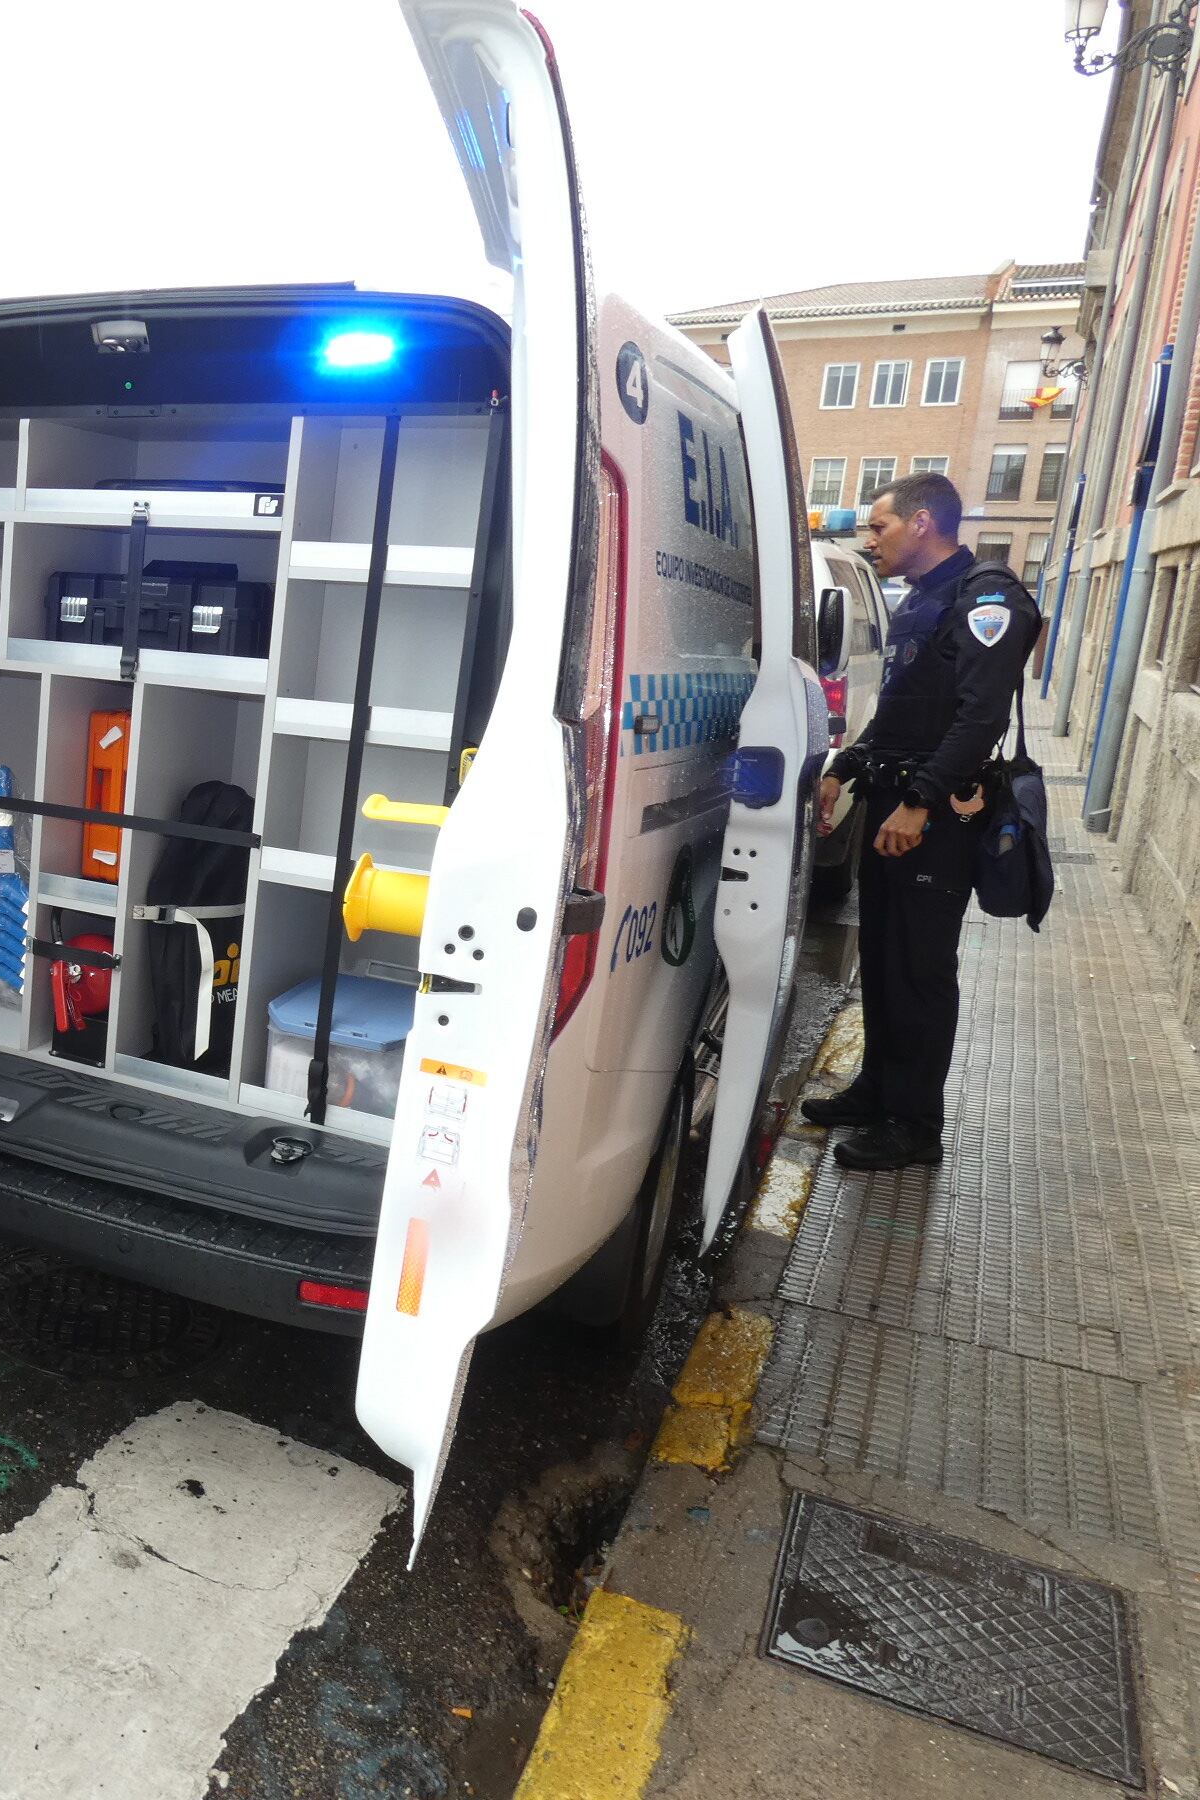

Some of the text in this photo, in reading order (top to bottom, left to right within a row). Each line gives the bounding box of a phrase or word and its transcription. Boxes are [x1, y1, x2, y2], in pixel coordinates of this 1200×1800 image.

[625, 359, 644, 408] 4
[656, 551, 684, 582] EQUIPO
[626, 901, 657, 963] 092
